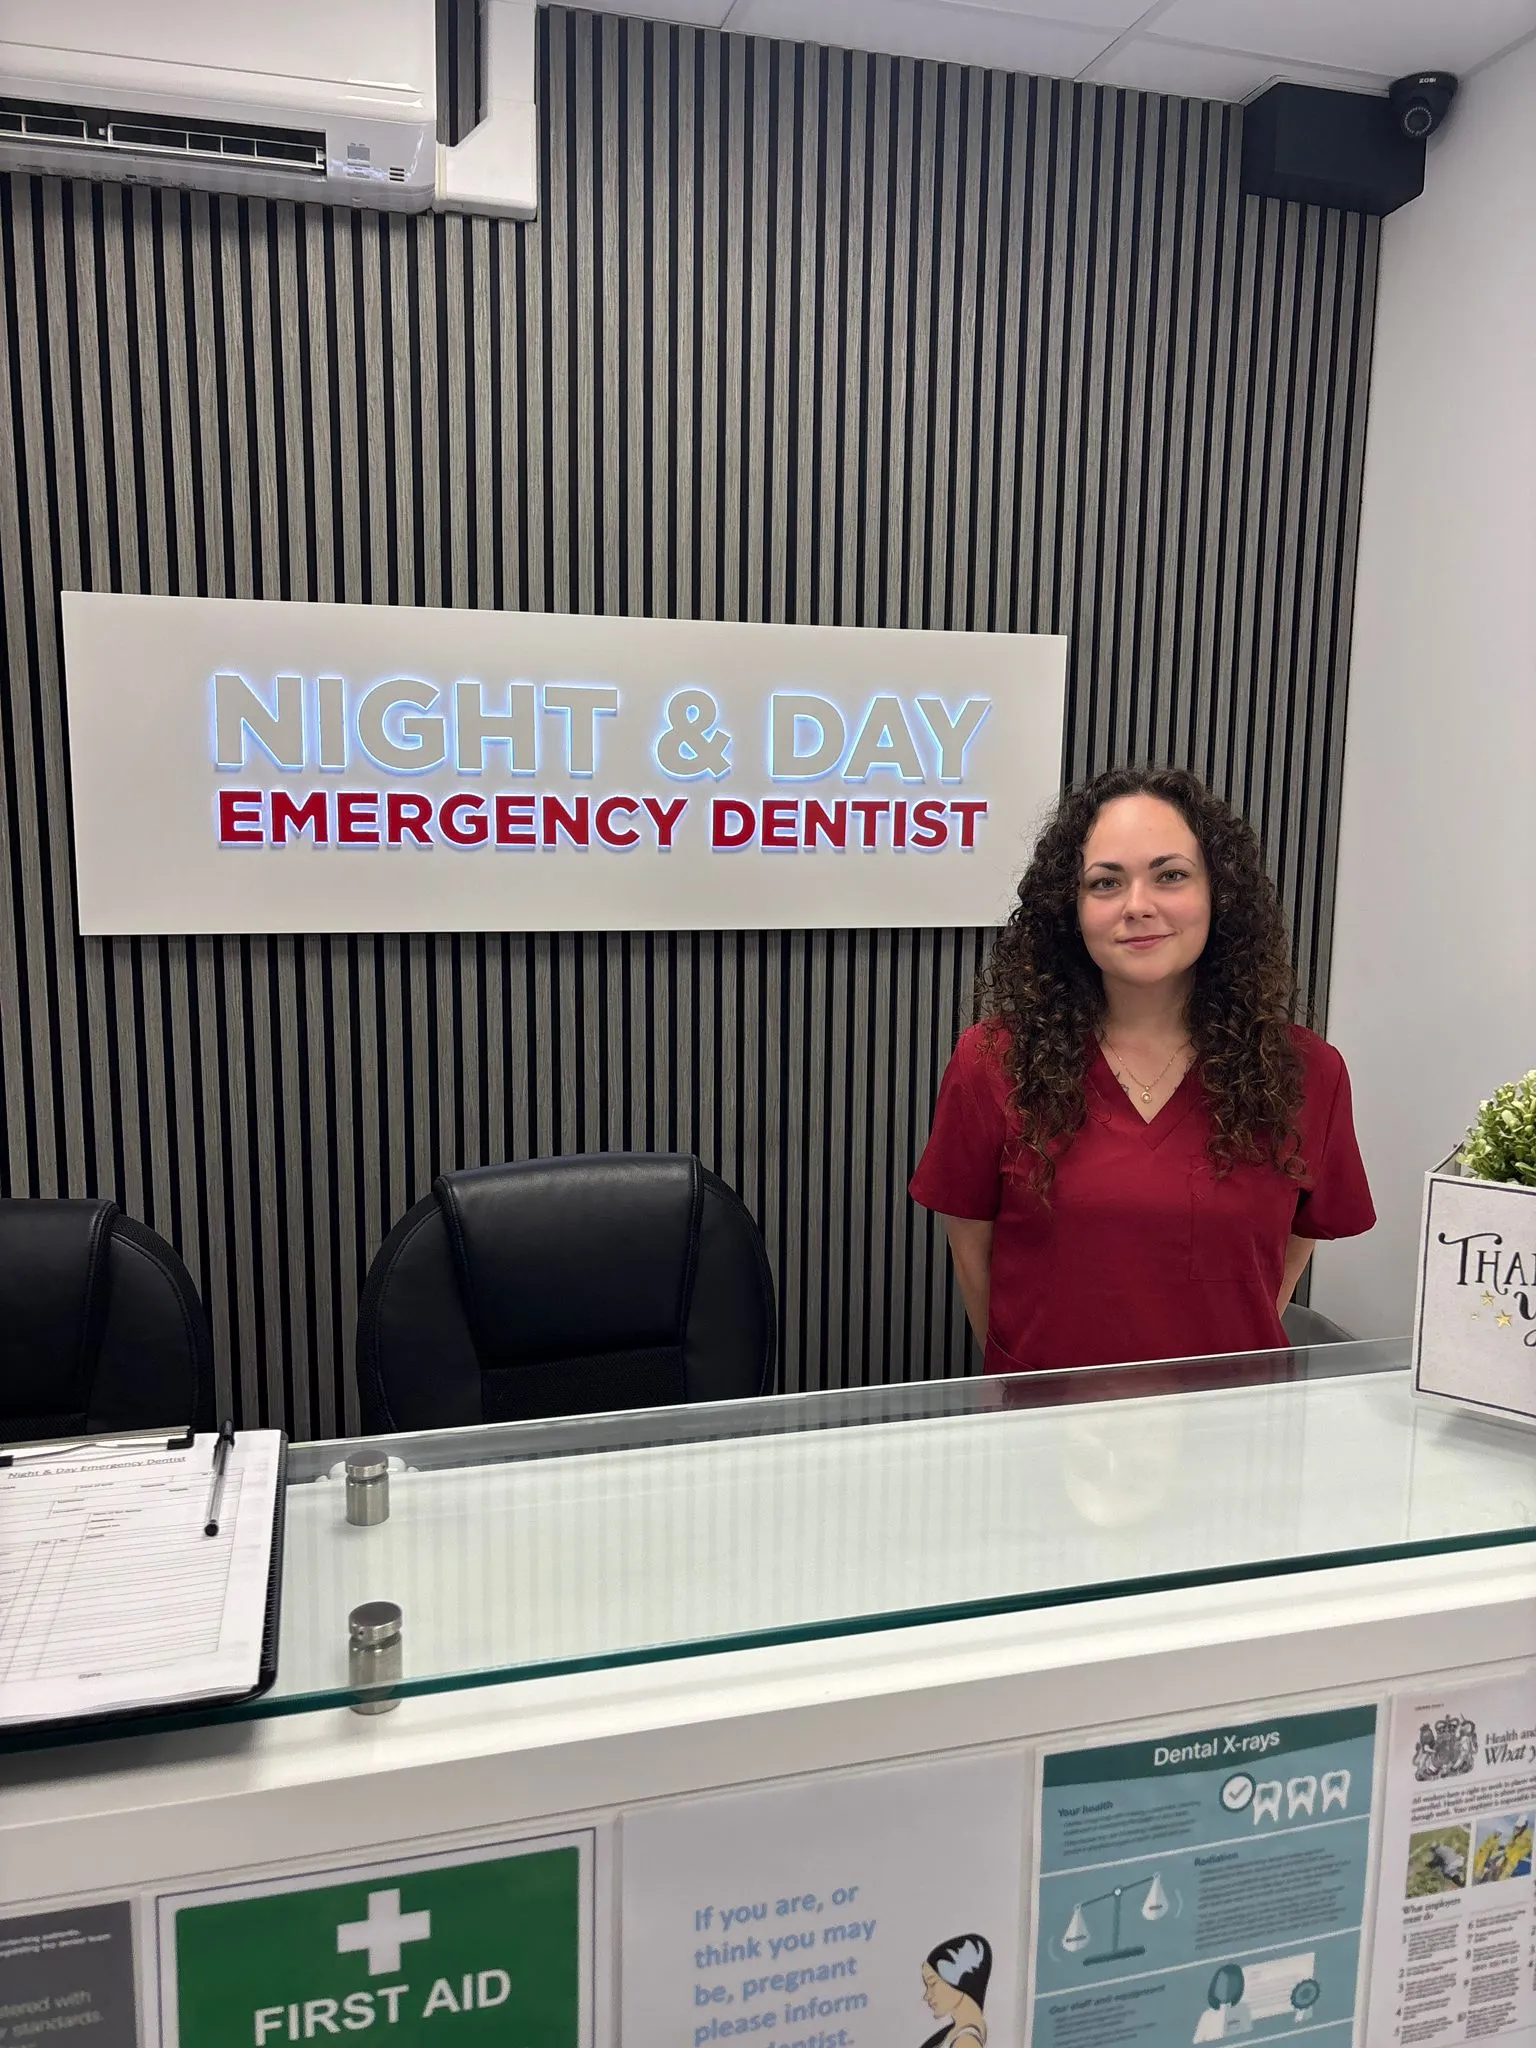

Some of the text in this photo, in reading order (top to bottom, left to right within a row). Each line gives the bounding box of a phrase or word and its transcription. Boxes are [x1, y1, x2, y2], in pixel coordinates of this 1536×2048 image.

[213, 673, 992, 781] NIGHT & DAY
[217, 789, 989, 849] EMERGENCY DENTIST
[1438, 1232, 1536, 1296] THA
[8, 1471, 39, 1479] Night
[80, 1461, 144, 1472] Emergency
[147, 1456, 187, 1466] Dentist
[1154, 1731, 1280, 1766] Dental X-rays
[1485, 1743, 1526, 1765] What
[1486, 1728, 1518, 1744] Health
[1058, 1800, 1113, 1817] Your health
[695, 1886, 859, 1932] If you are, or
[694, 1919, 876, 1969] think you may
[54, 1990, 92, 2008] with
[695, 1956, 857, 2007] be, pregnant
[253, 1968, 511, 2046] FIRST AID
[694, 1992, 869, 2047] please inform
